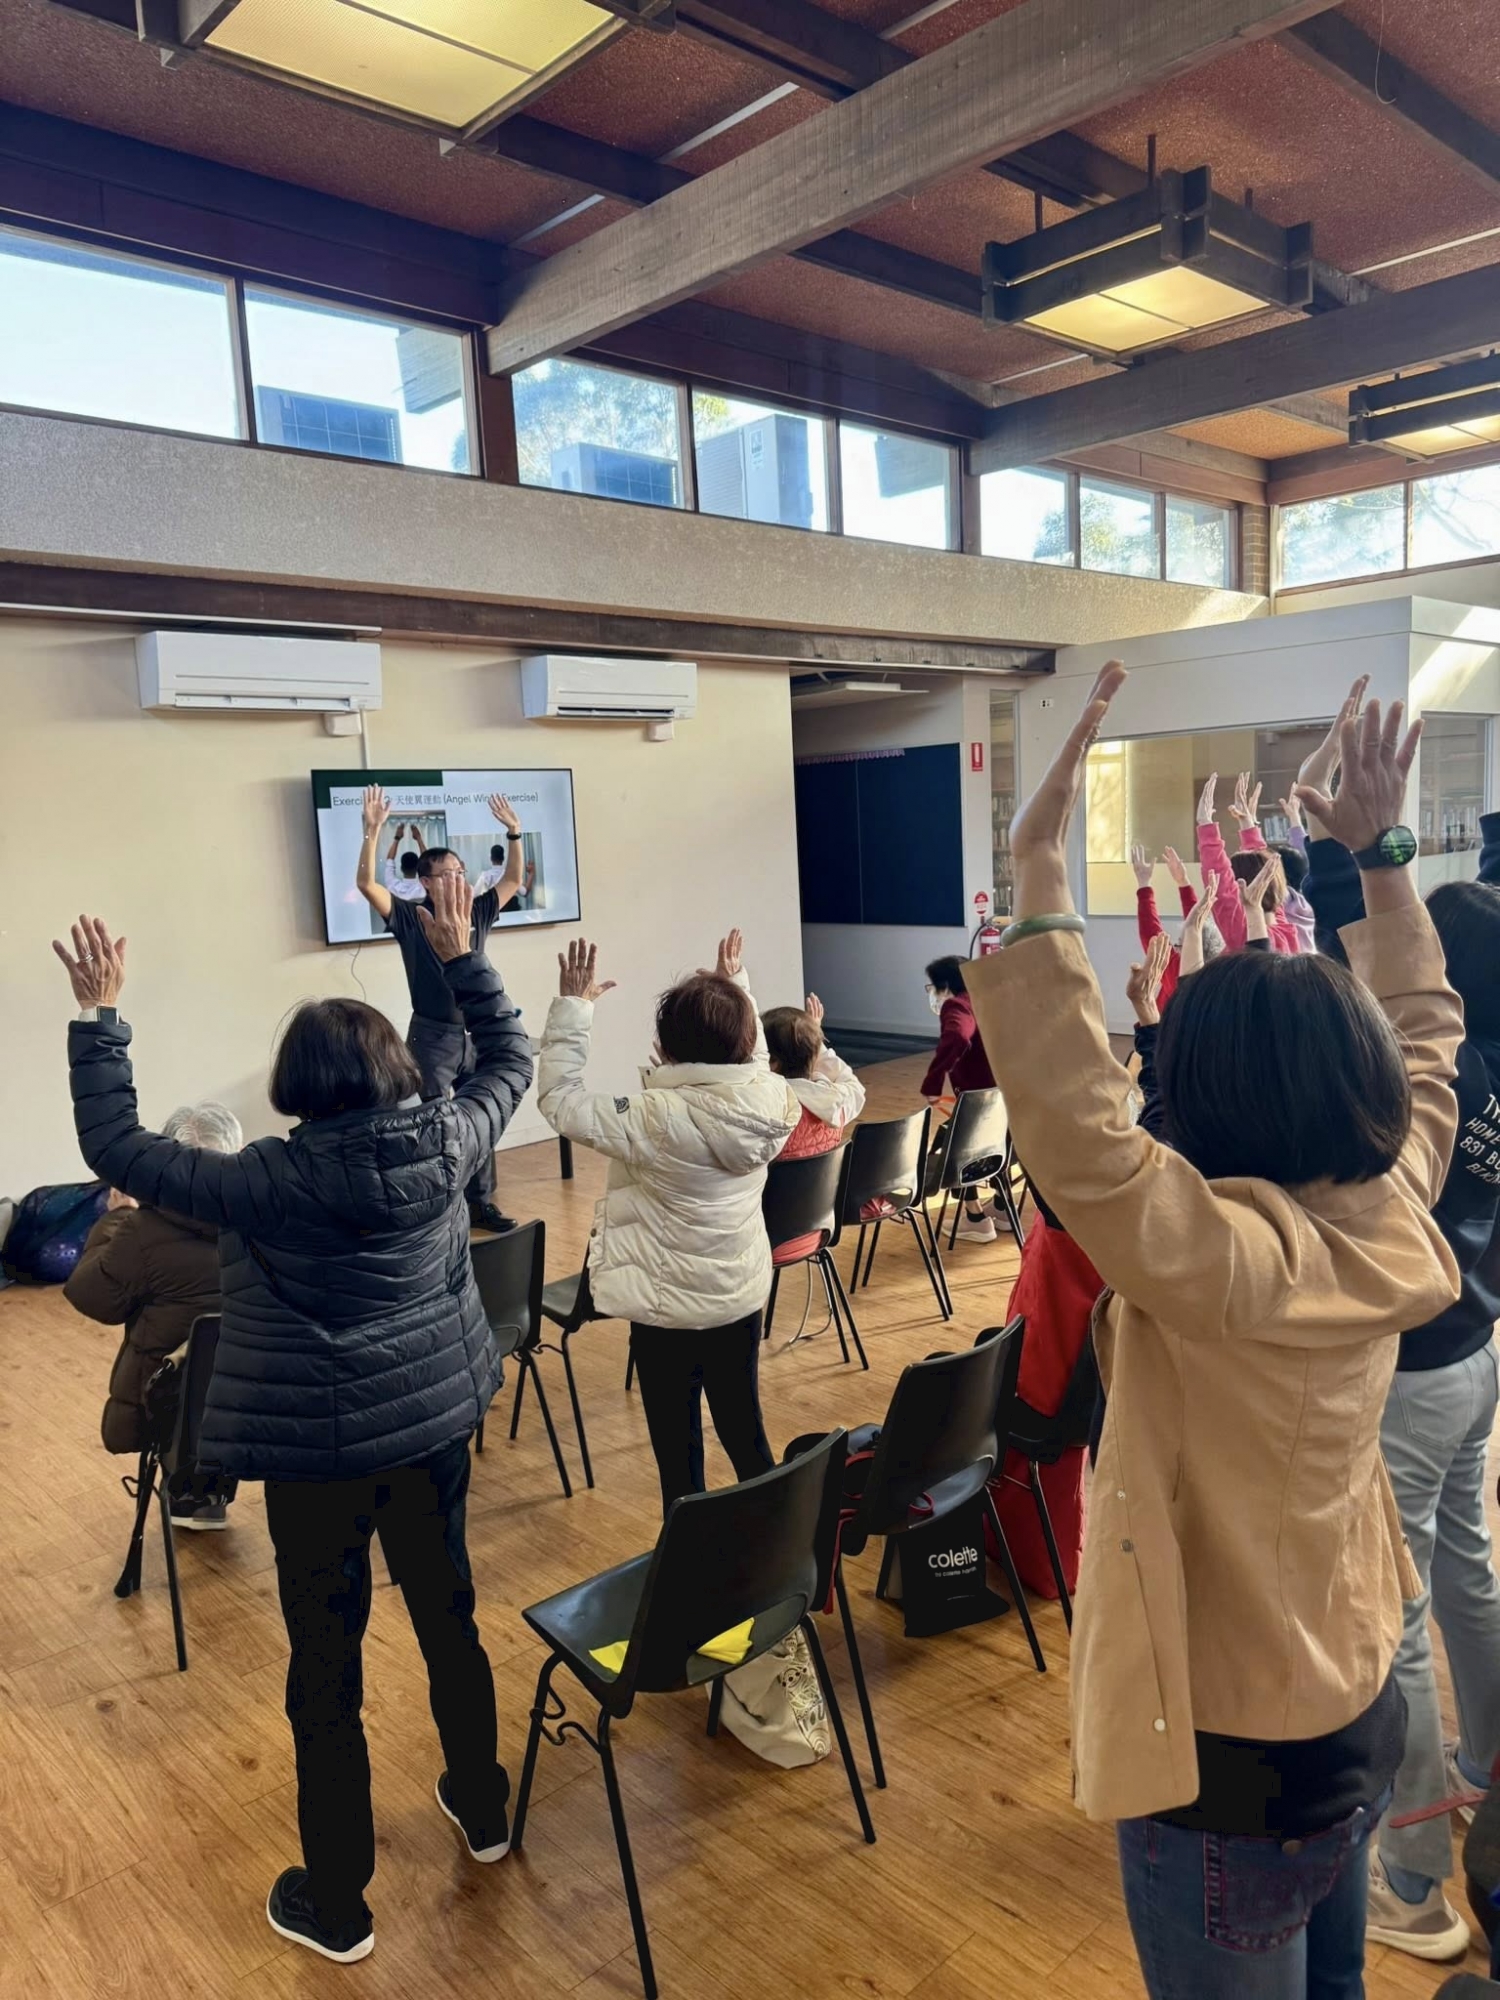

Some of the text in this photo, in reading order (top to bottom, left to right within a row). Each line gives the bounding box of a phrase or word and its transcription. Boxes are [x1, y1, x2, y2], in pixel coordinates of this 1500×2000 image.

[332, 796, 372, 806] Exerci
[443, 793, 471, 805] (Angel
[1459, 1135, 1486, 1157] 831
[927, 1545, 979, 1569] colette
